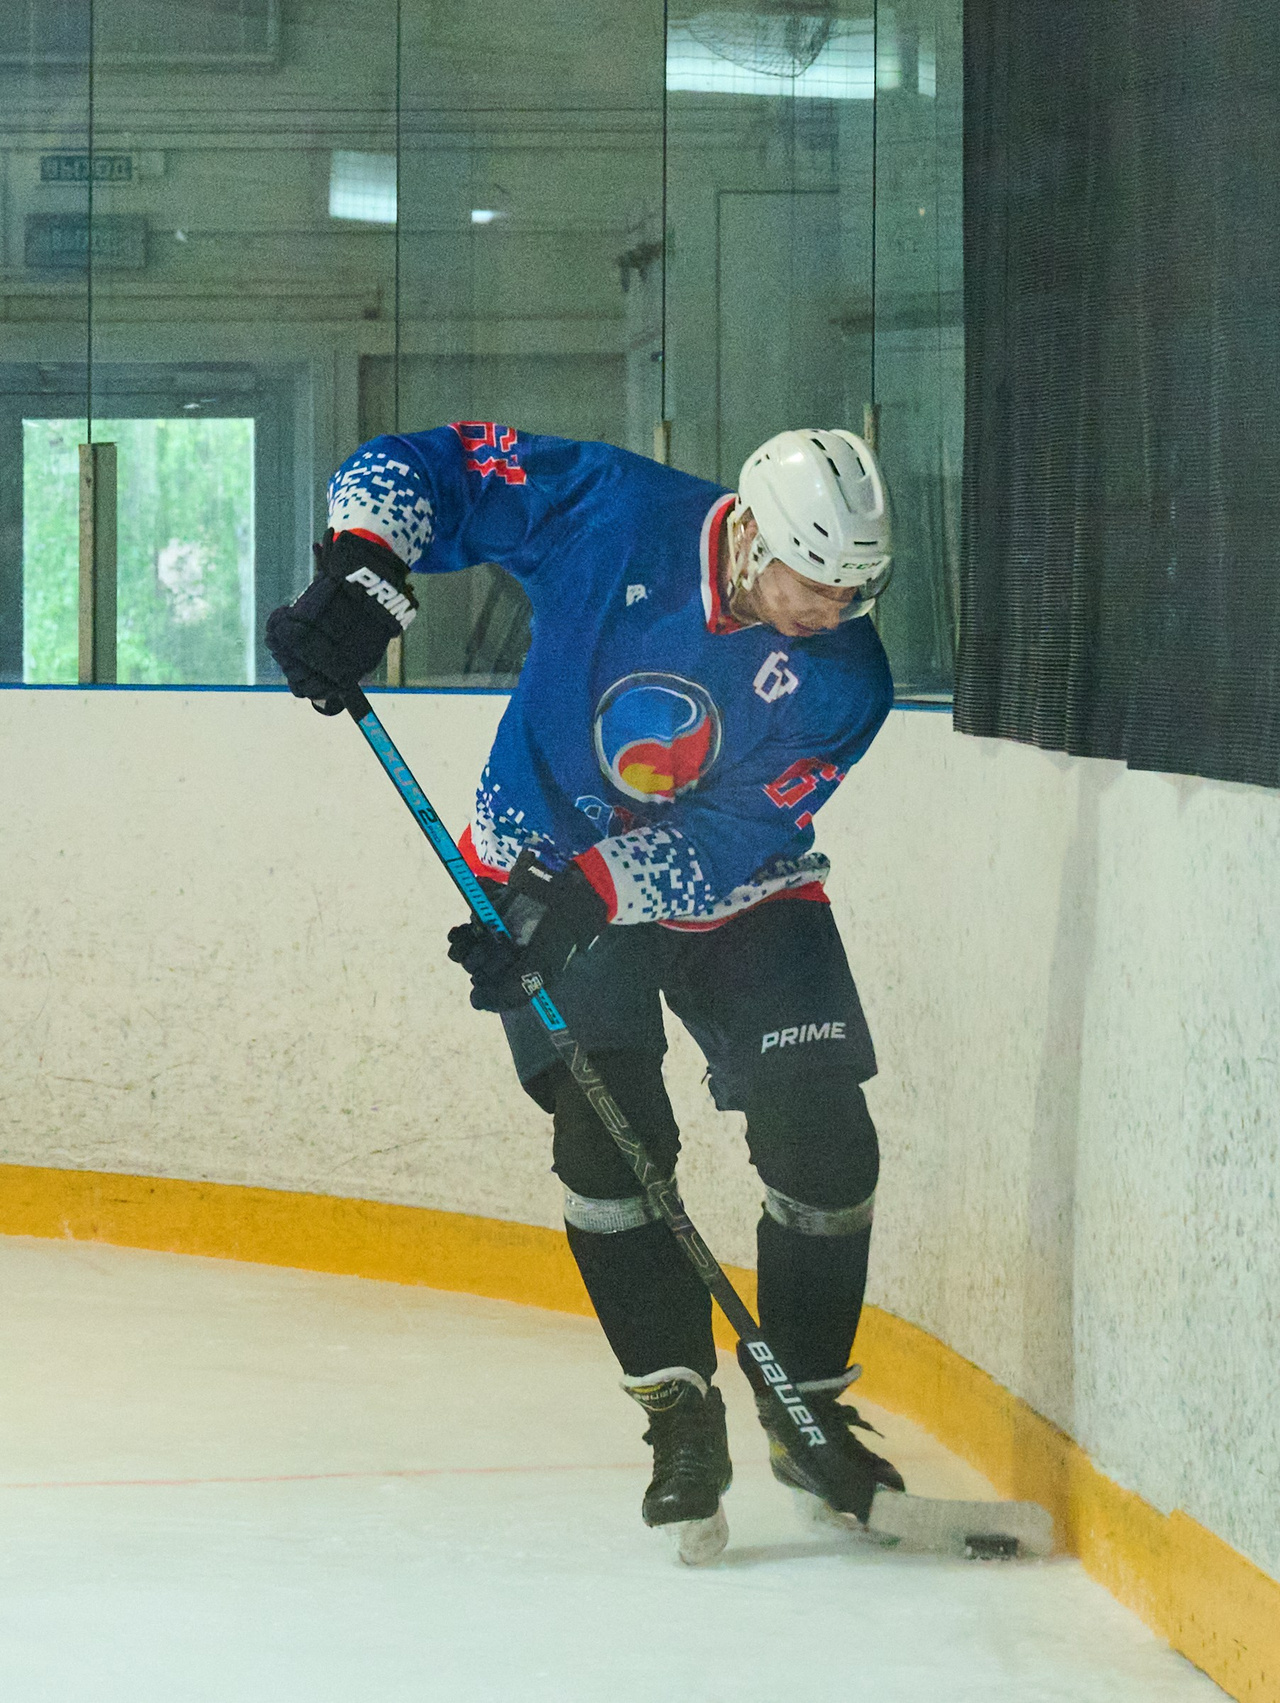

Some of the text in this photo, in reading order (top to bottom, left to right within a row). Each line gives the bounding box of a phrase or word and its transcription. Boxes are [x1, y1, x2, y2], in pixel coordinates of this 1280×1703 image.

[418, 807, 438, 825] 2
[761, 1021, 846, 1055] PRIME
[746, 1341, 827, 1447] BAUER
